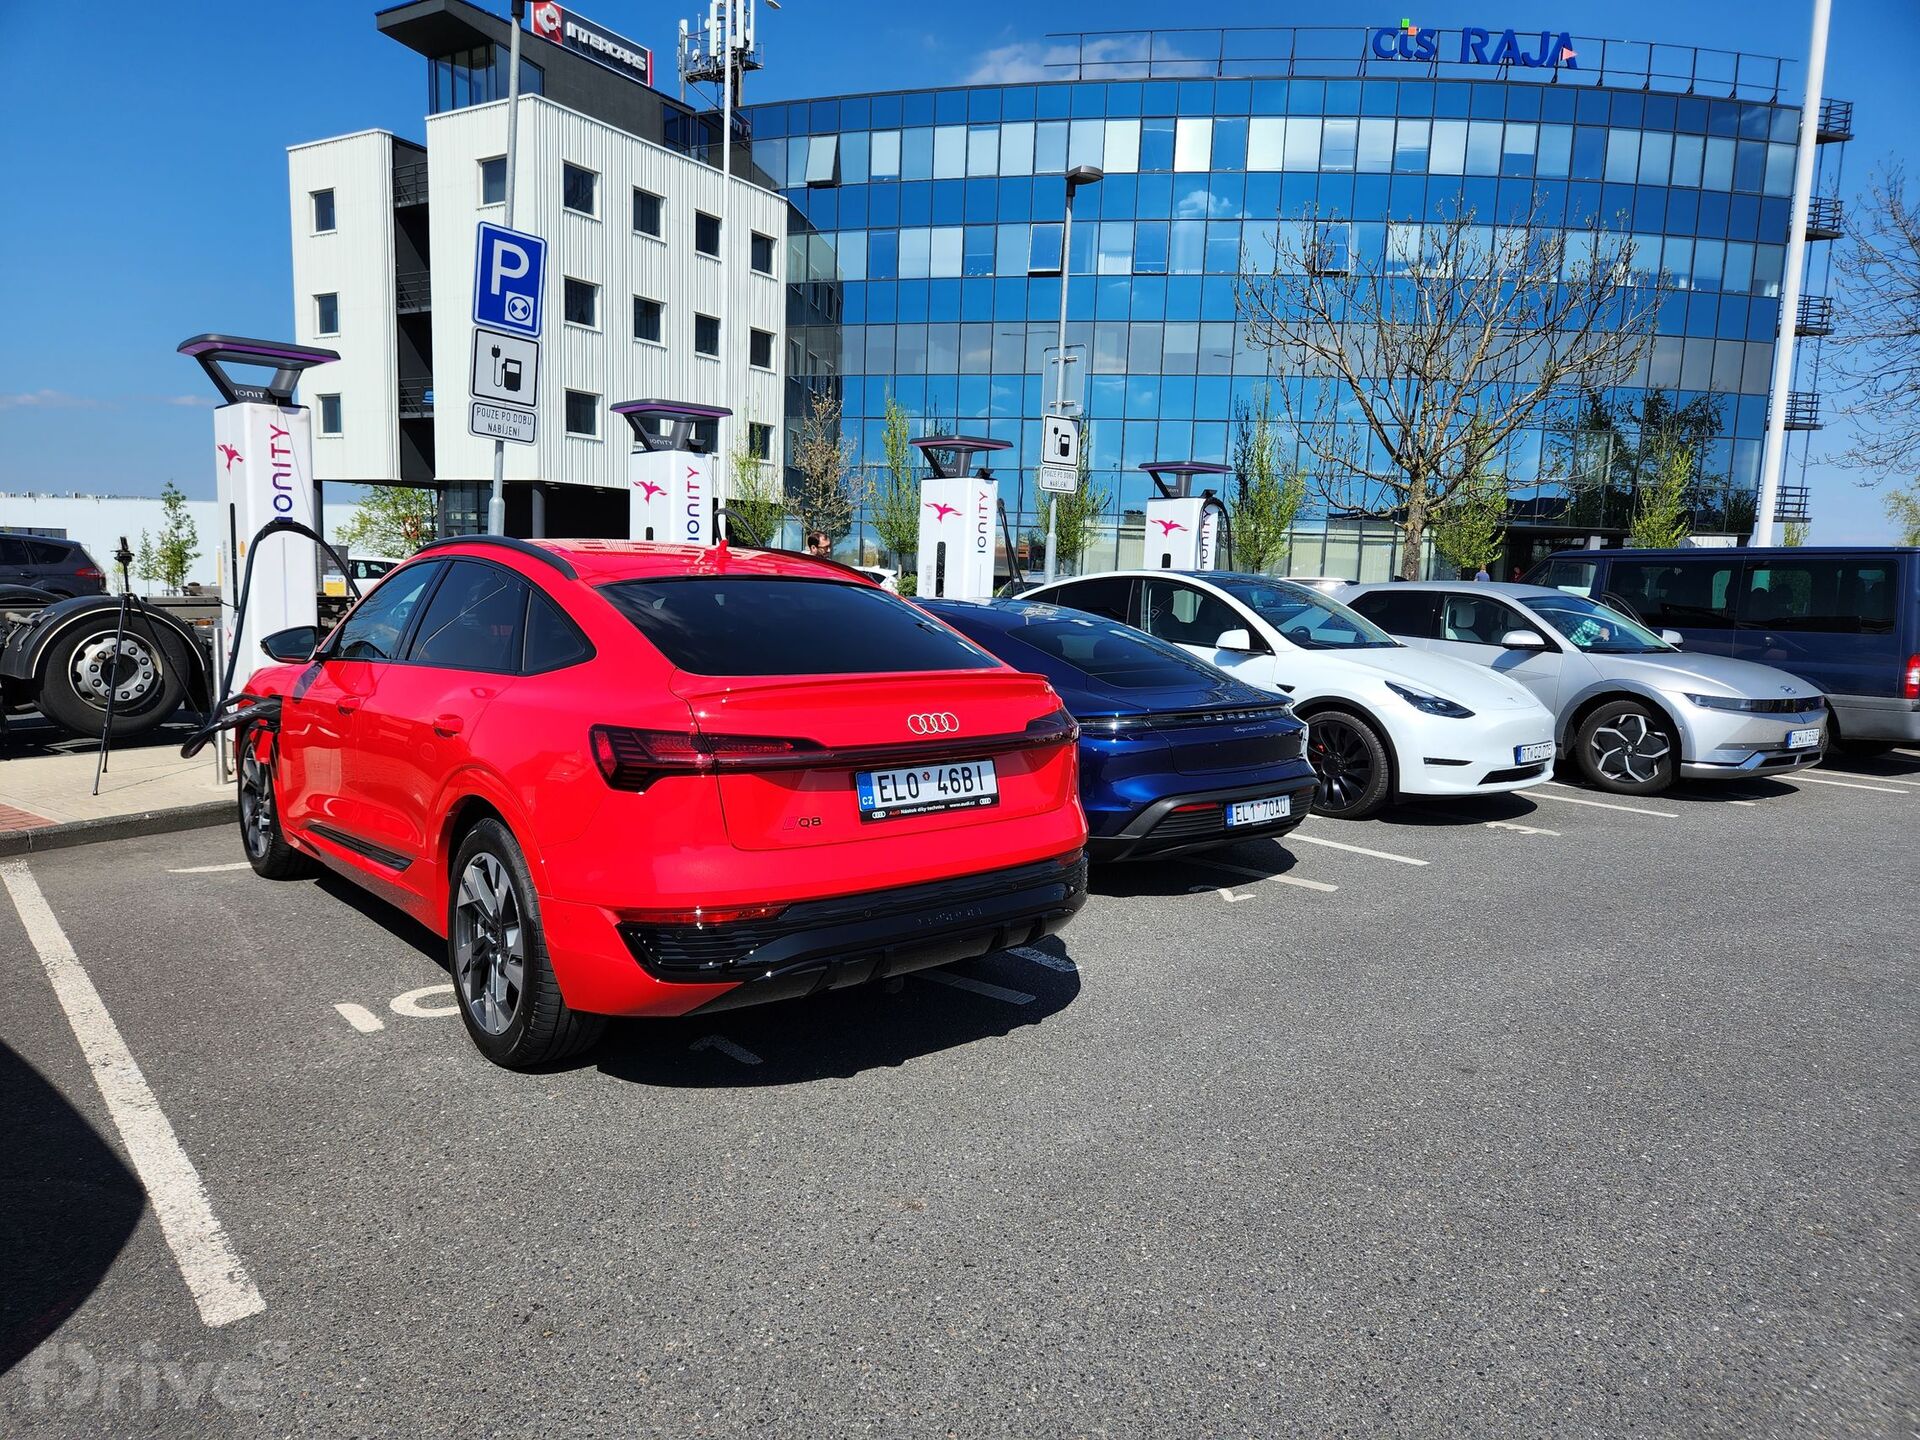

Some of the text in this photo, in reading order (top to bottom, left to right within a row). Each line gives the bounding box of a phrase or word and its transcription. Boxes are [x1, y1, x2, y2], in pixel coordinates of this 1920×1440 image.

[1460, 27, 1578, 69] RAJA
[490, 238, 530, 296] P
[476, 406, 532, 426] POUZE PO DOBU
[269, 423, 293, 524] IONITY
[687, 466, 700, 541] IONITY
[977, 491, 989, 554] IONITY
[799, 817, 821, 828] Q8
[862, 796, 874, 805] CZ
